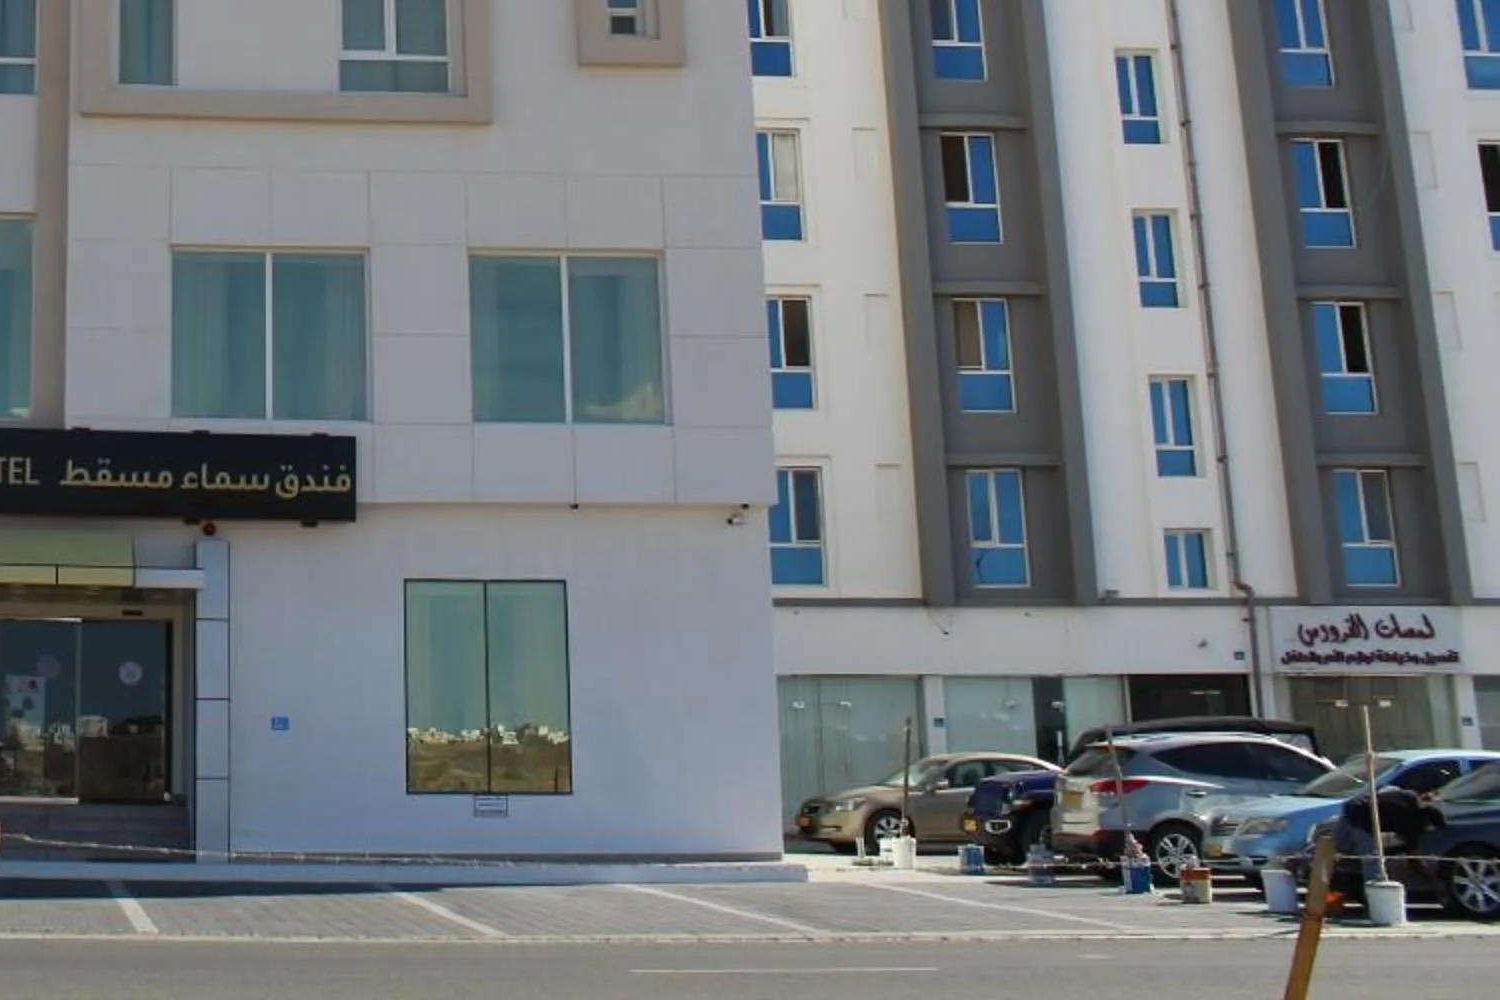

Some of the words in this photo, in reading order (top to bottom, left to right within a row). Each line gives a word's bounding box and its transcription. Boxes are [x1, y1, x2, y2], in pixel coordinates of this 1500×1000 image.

[59, 457, 173, 488] مسقط
[180, 462, 270, 491] سماء
[275, 464, 351, 499] فندق
